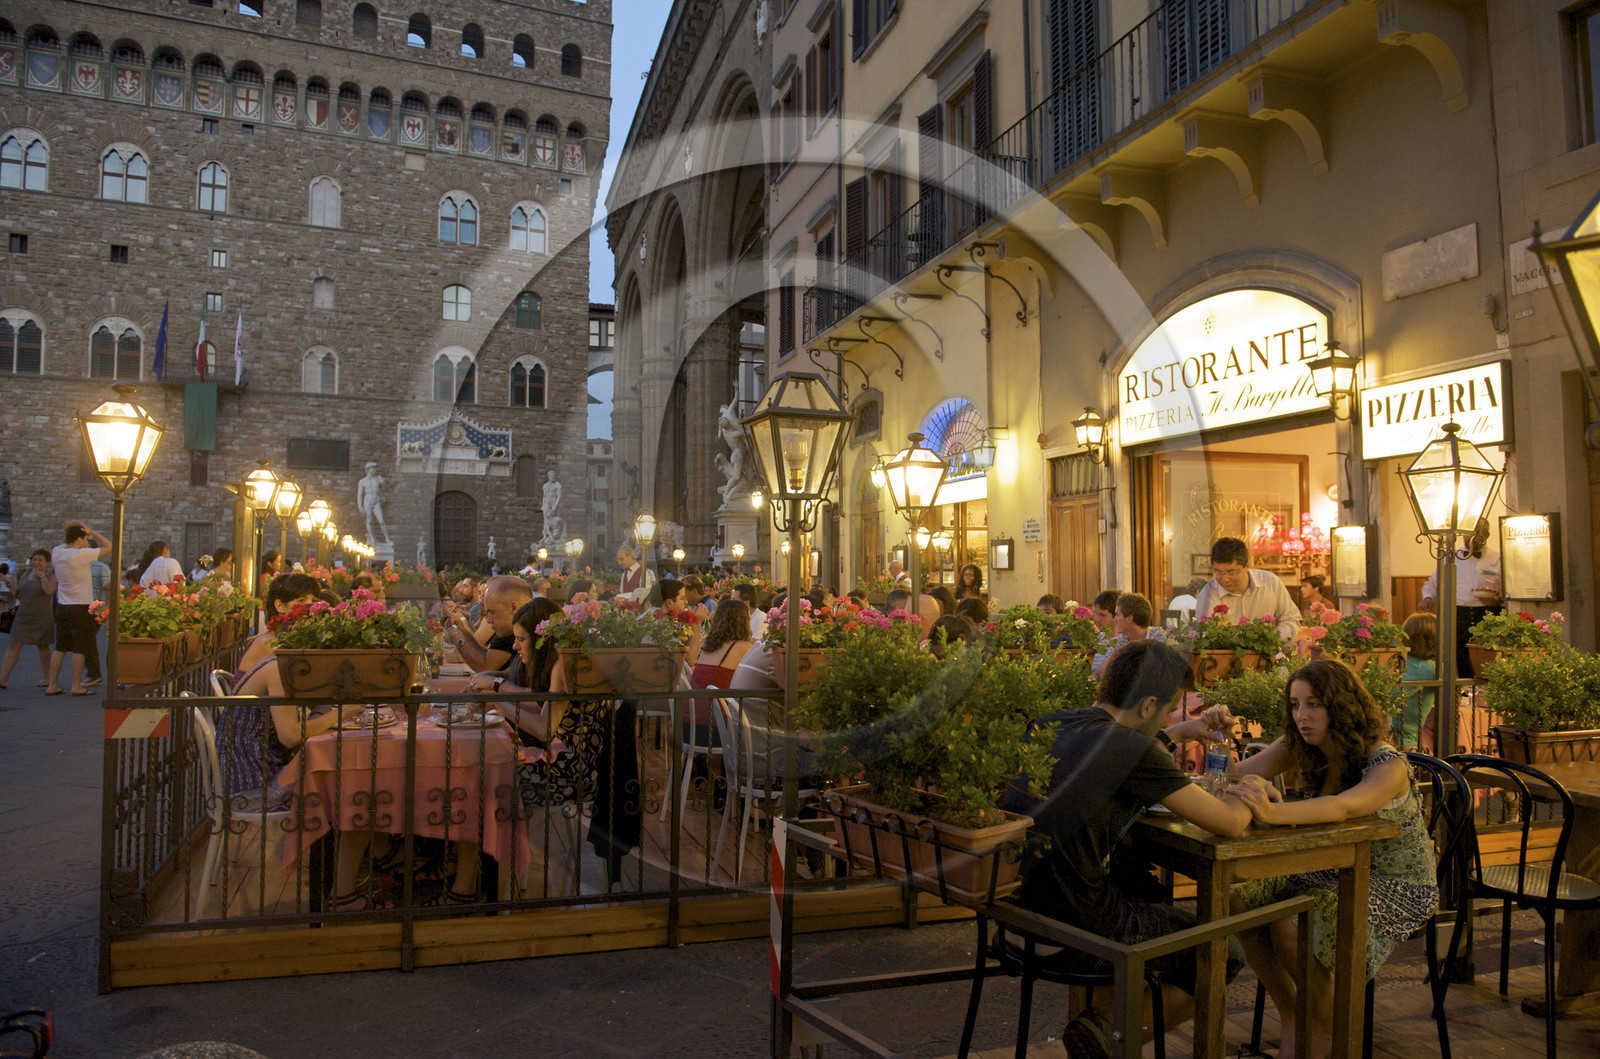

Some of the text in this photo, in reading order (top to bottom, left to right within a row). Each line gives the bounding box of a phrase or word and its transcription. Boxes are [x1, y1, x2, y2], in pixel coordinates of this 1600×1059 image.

[1124, 322, 1319, 404] RISTORANTE
[1367, 376, 1500, 428] PIZZERIA
[1125, 404, 1195, 432] PIZZERIA
[1187, 498, 1274, 527] RISTORANTE
[1508, 525, 1550, 537] PIZZERIA
